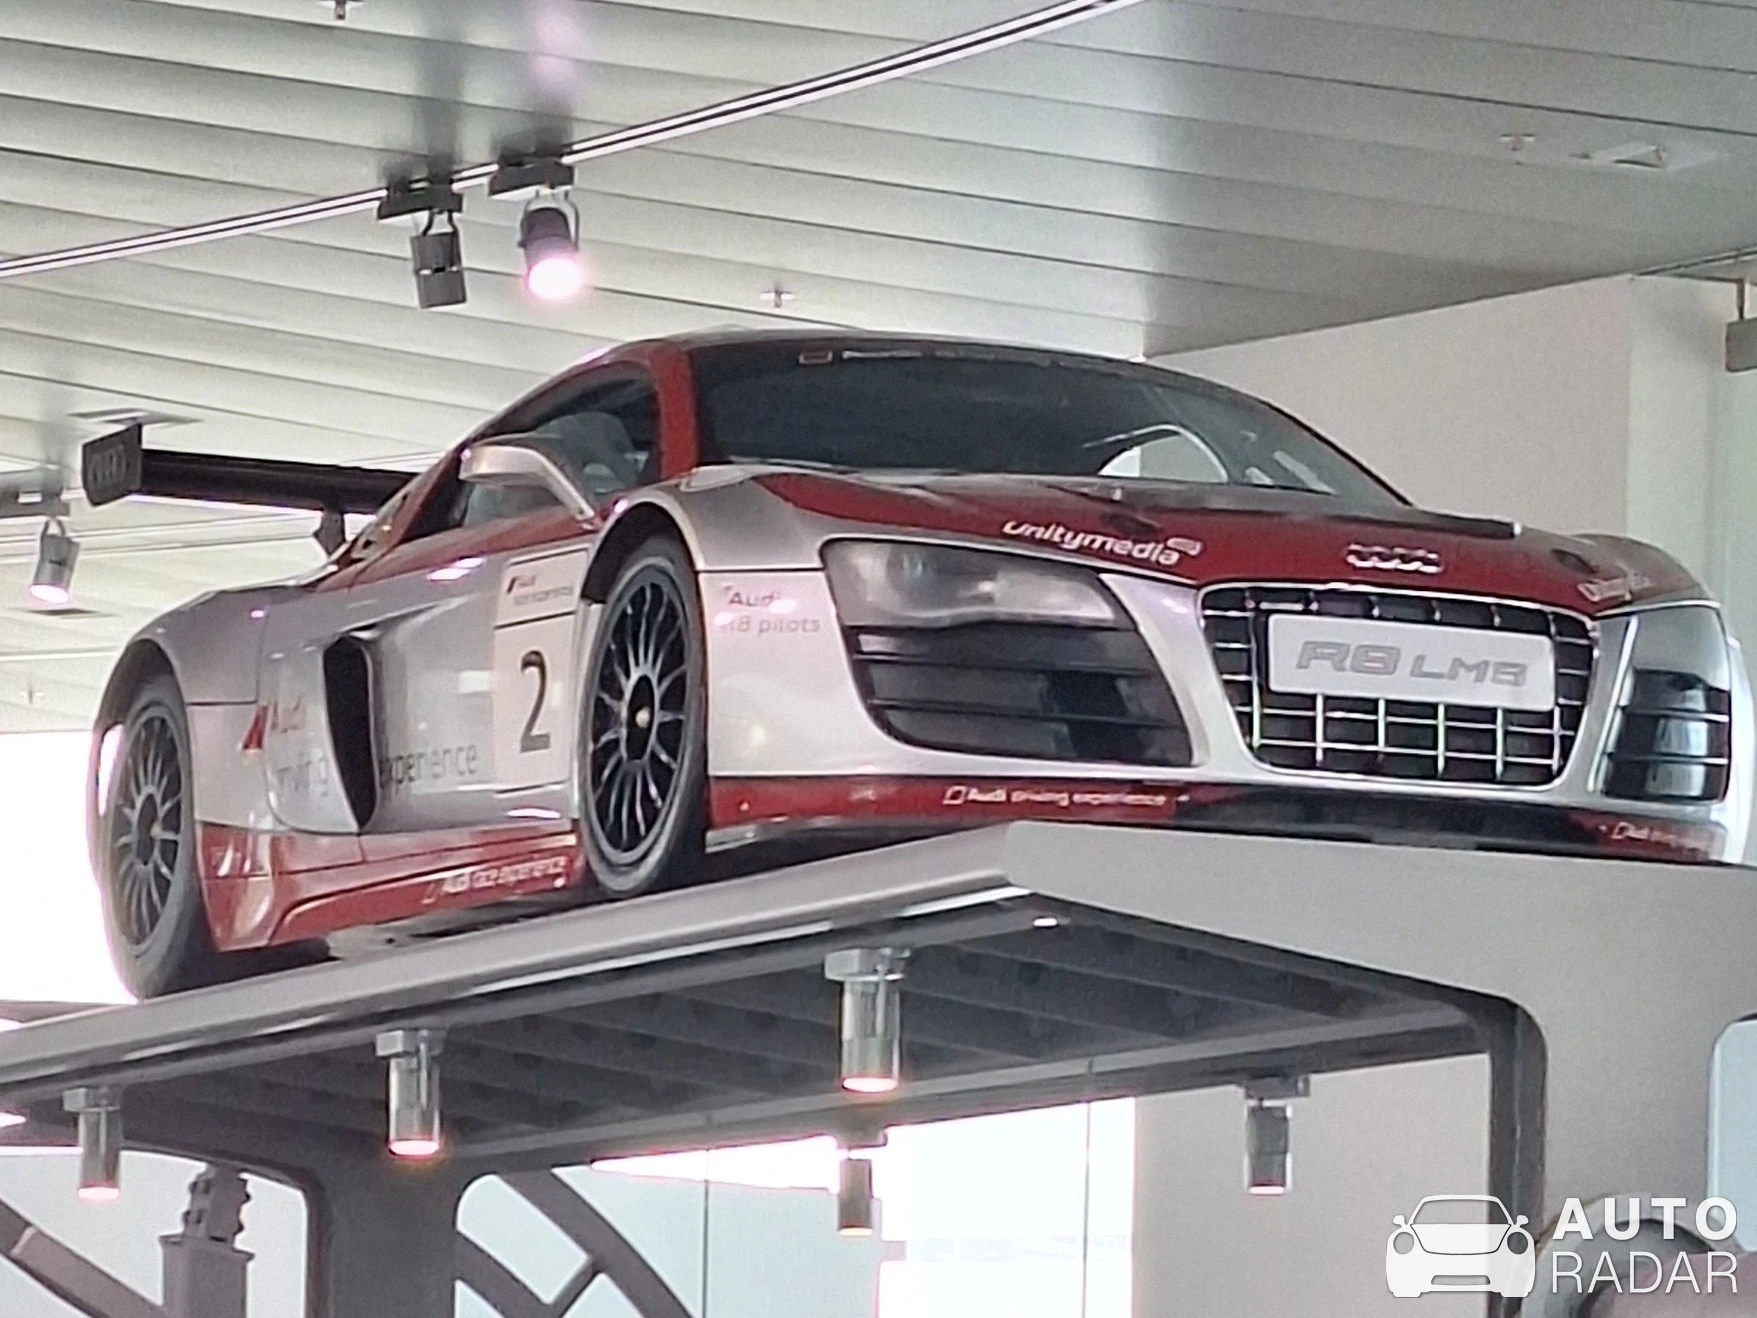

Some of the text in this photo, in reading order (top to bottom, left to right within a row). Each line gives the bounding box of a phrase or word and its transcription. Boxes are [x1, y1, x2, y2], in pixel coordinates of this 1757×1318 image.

[1002, 520, 1181, 565] unitymedia
[757, 617, 821, 637] pilots
[1296, 640, 1401, 676] R8
[519, 650, 551, 753] 2
